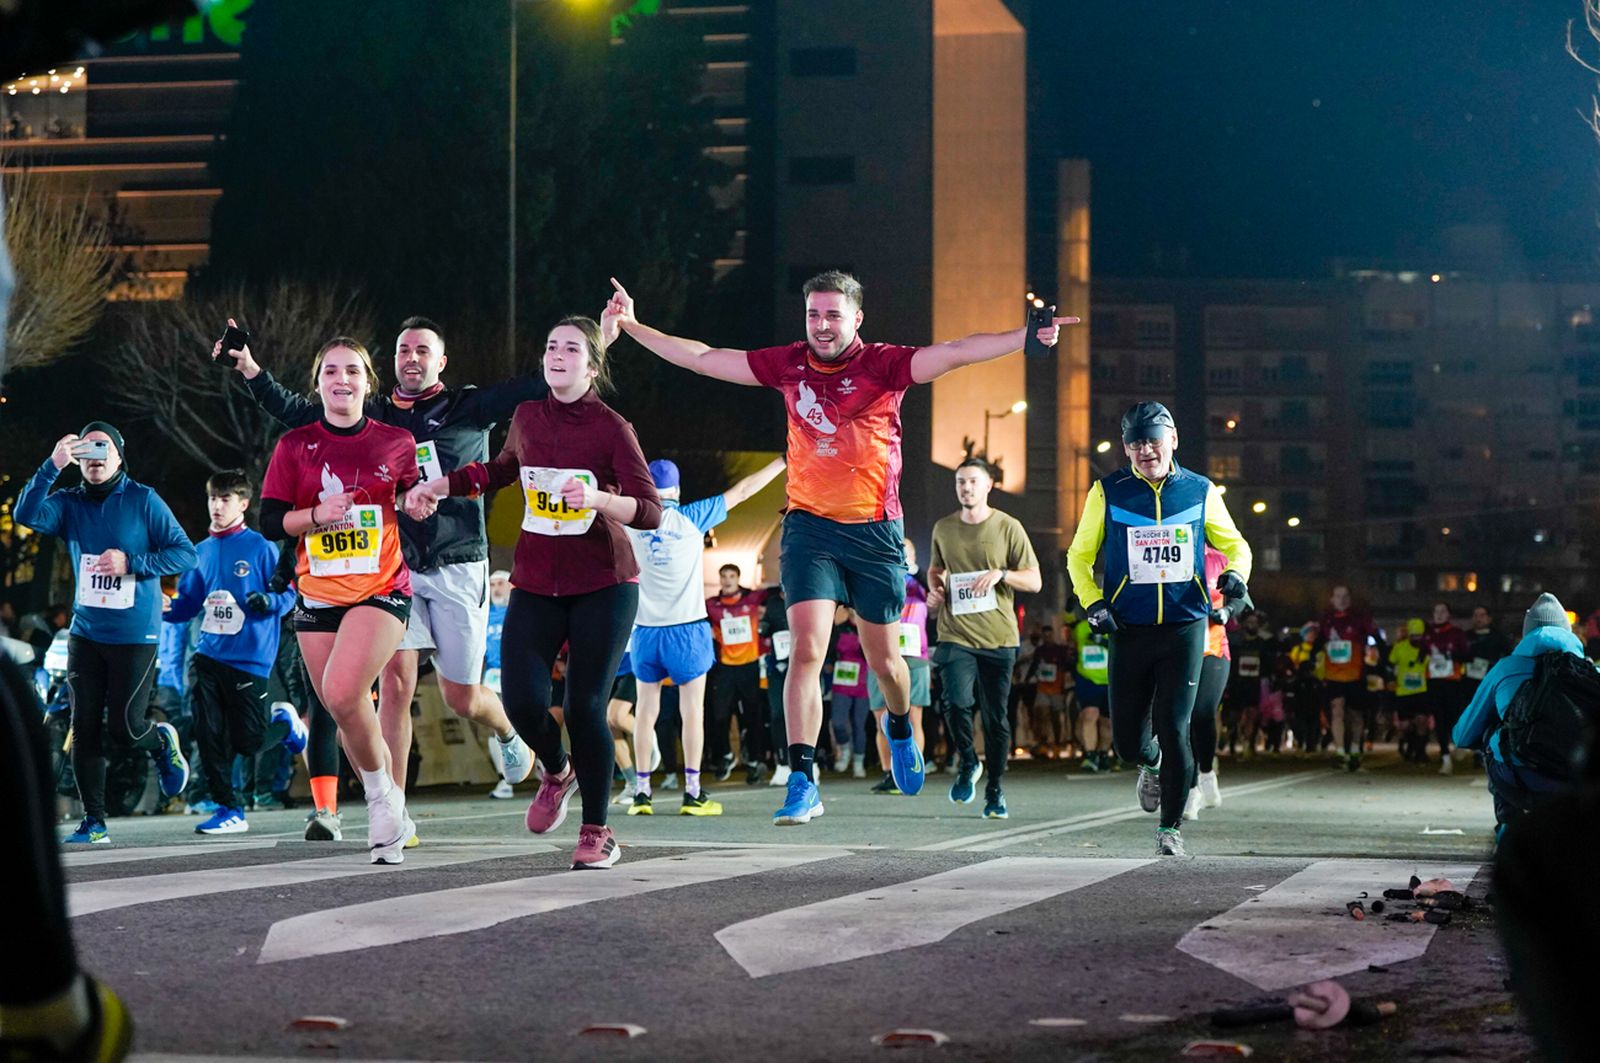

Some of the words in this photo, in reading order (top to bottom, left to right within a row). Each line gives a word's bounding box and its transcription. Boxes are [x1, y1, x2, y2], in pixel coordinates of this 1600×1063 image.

[806, 408, 823, 425] 43
[321, 529, 369, 554] 9613
[1142, 545, 1182, 564] 4749
[91, 574, 122, 591] 1104
[213, 606, 233, 619] 466
